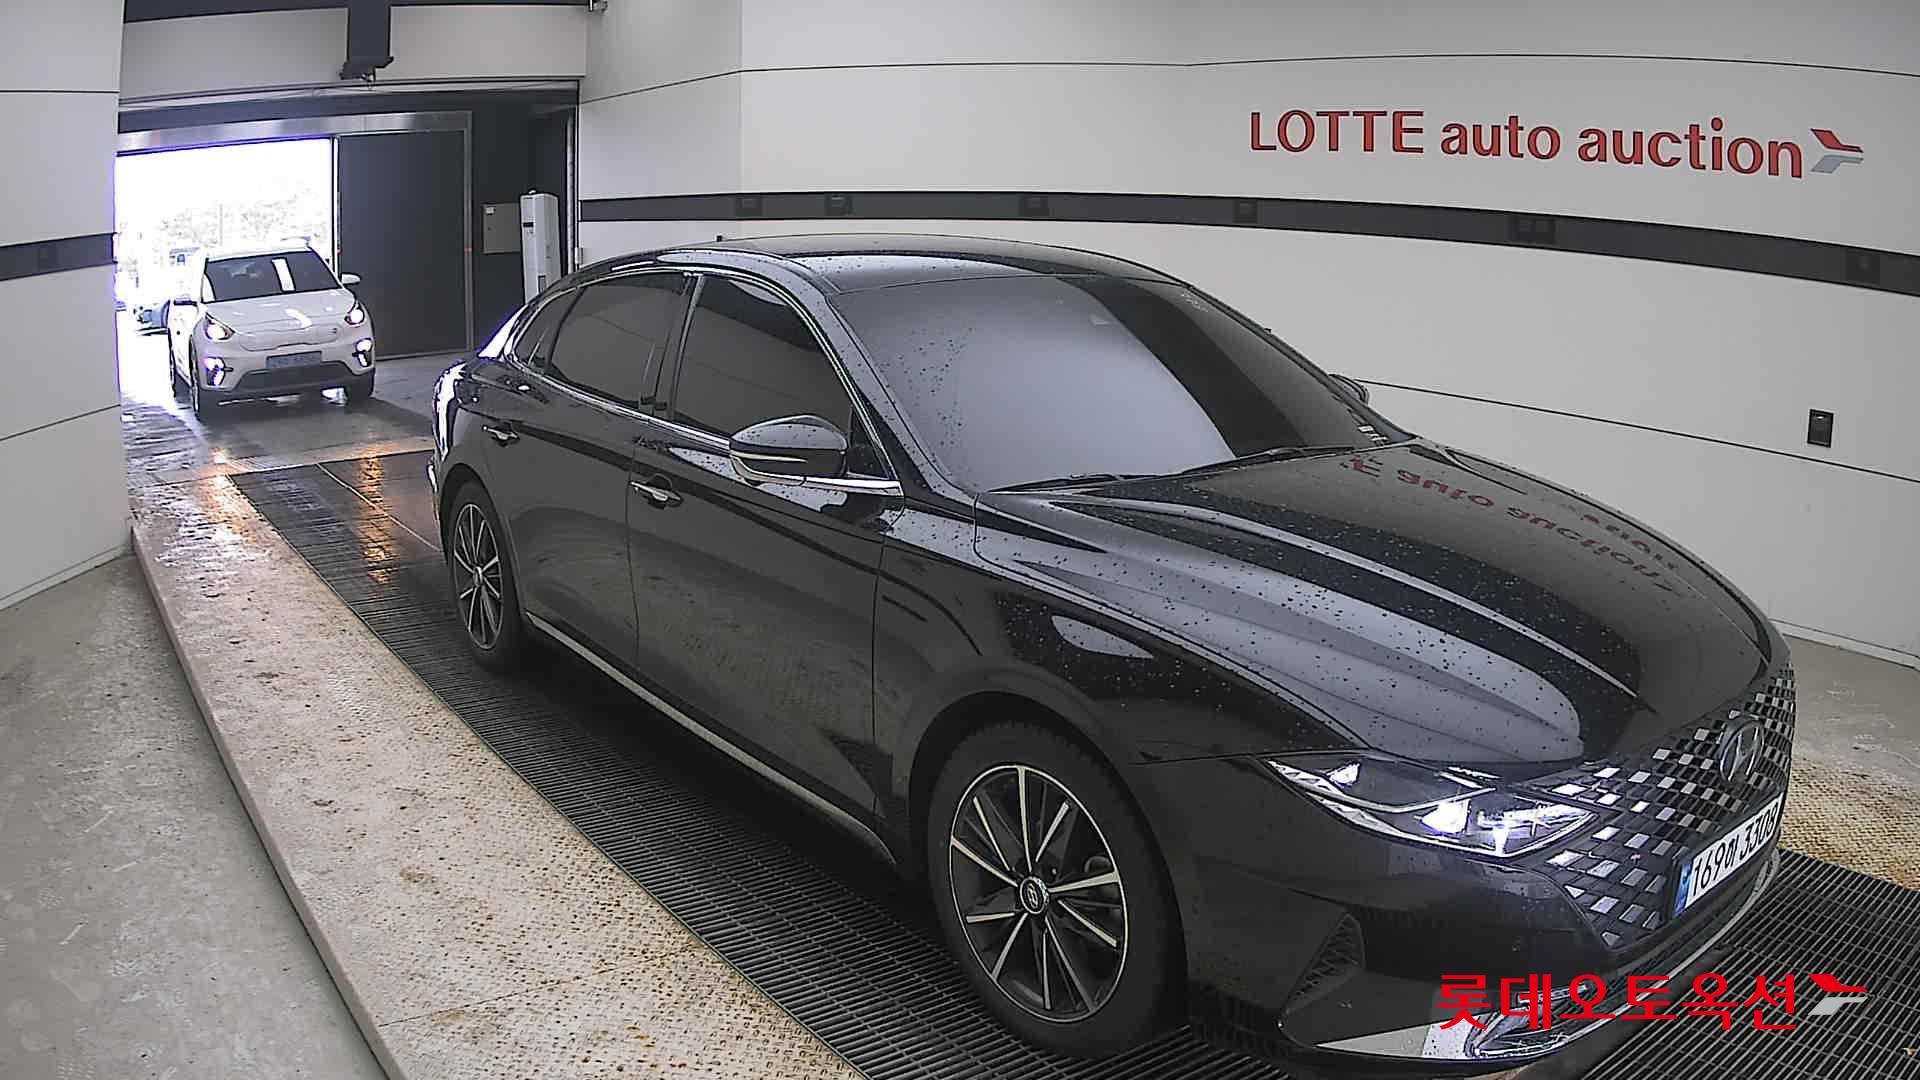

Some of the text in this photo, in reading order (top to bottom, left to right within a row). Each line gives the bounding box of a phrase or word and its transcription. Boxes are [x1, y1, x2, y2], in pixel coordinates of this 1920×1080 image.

[1250, 110, 1803, 179] LOTTE auto auction
